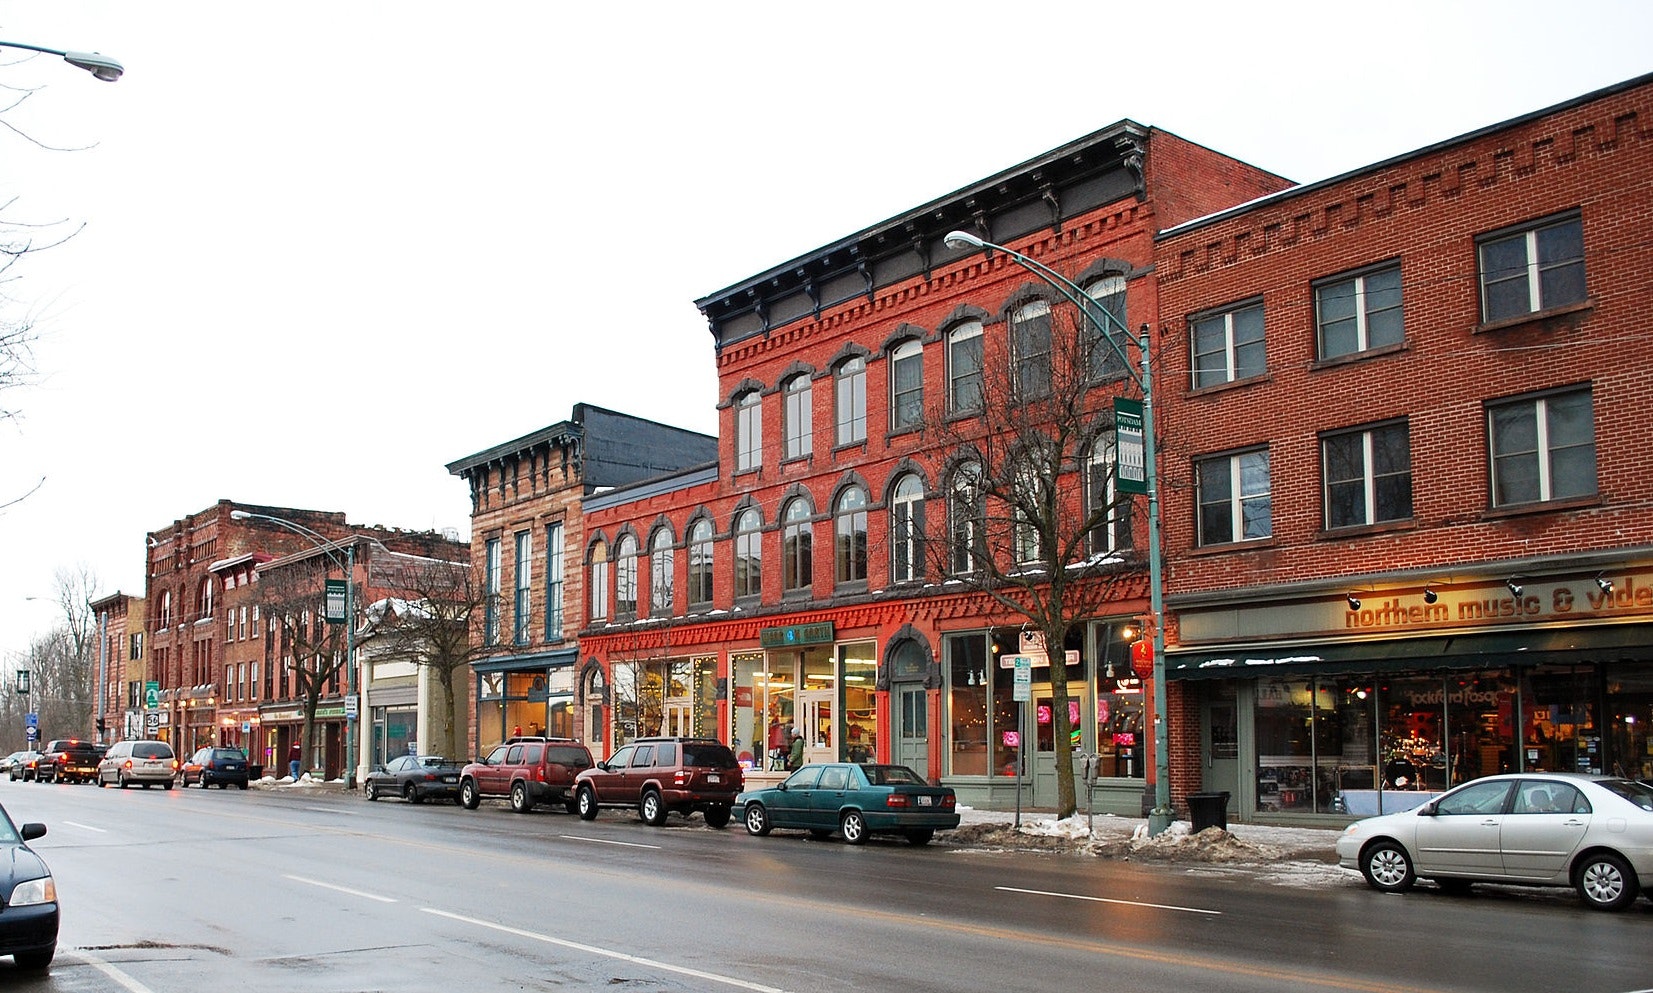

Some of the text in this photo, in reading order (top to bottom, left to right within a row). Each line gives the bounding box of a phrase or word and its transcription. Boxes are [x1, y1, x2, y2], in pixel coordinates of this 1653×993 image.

[1346, 598, 1449, 628] northern
[1458, 594, 1541, 620] music
[1552, 587, 1575, 613] &
[148, 716, 158, 724] 56
